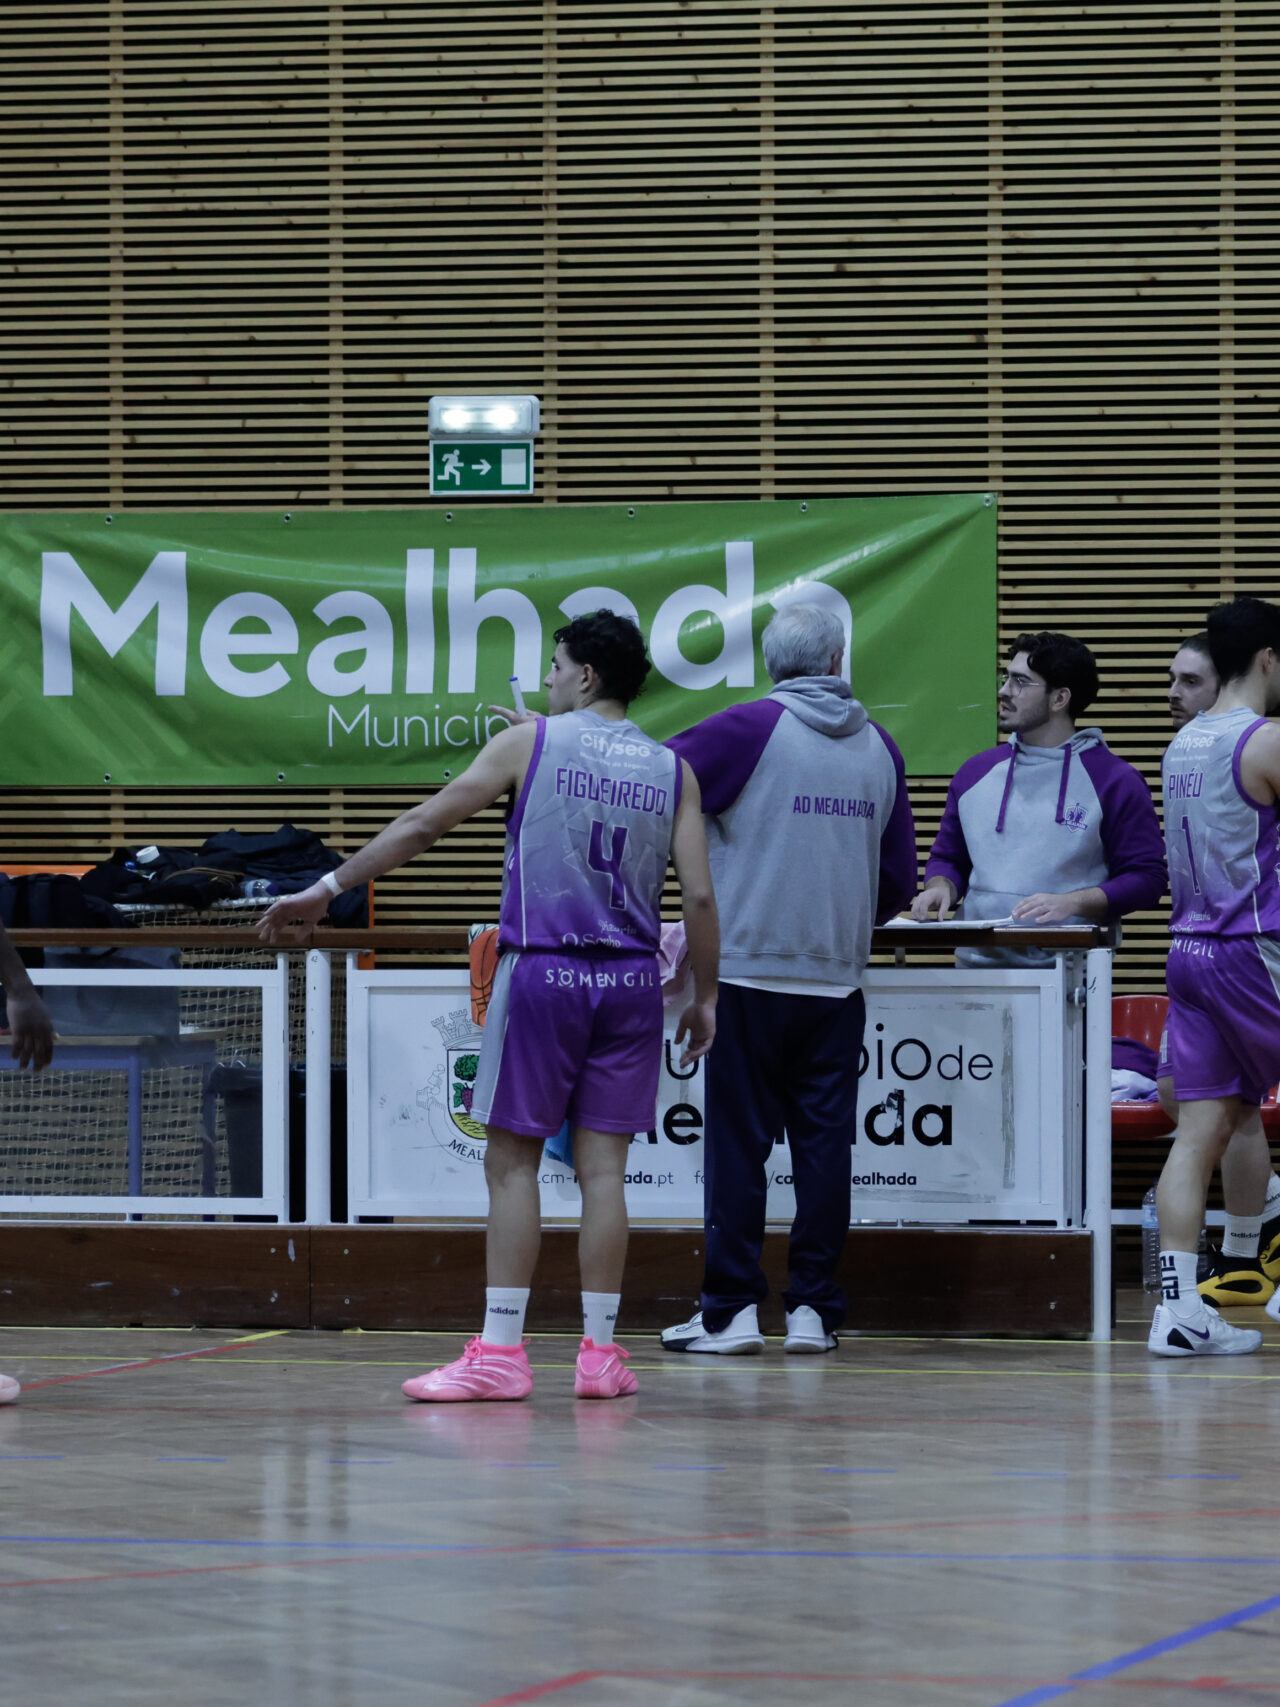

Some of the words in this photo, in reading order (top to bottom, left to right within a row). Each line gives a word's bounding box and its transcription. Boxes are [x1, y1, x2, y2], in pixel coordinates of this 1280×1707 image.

[328, 702, 512, 747] Municíp
[556, 767, 668, 817] FIGUEIREDO
[1168, 767, 1204, 800] PINÉU
[793, 795, 811, 814] AD
[586, 819, 630, 910] 4
[1181, 815, 1202, 896] 1
[936, 1044, 994, 1081] de
[449, 1139, 484, 1161] MEAL
[489, 1306, 519, 1316] adidas
